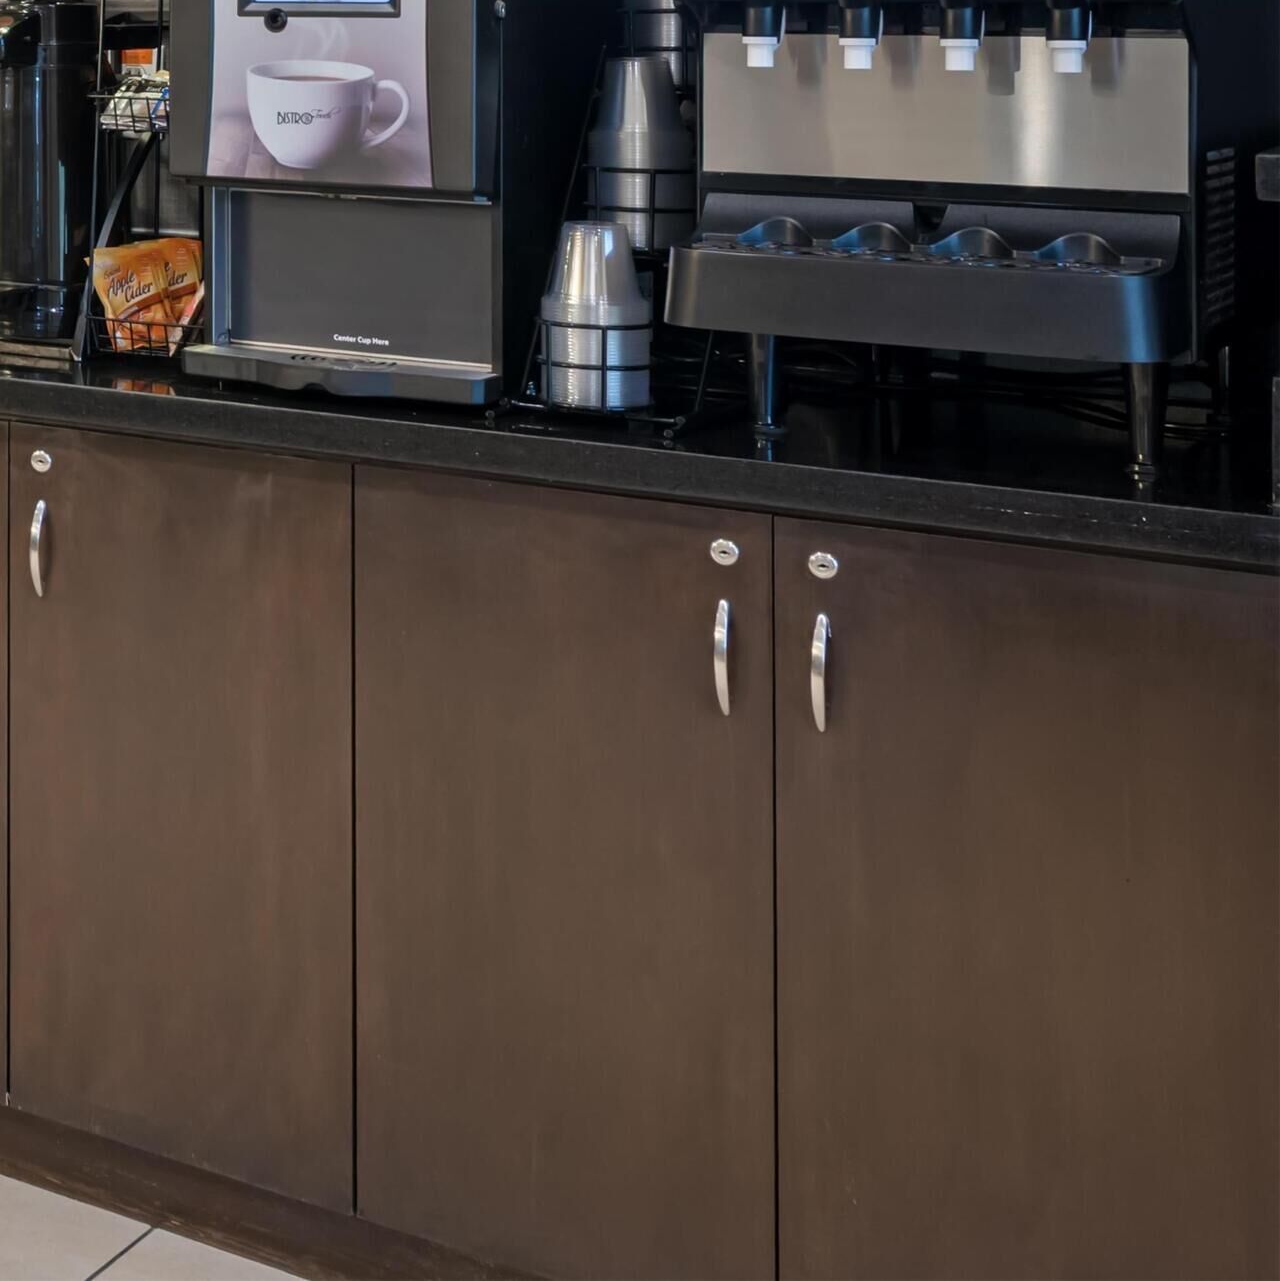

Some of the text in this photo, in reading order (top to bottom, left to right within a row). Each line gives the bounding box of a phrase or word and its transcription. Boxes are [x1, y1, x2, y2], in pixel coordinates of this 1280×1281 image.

[277, 111, 312, 125] BISTRO
[107, 270, 135, 298] Apple
[125, 283, 153, 303] Cider
[333, 334, 389, 346] Center Cup Here
